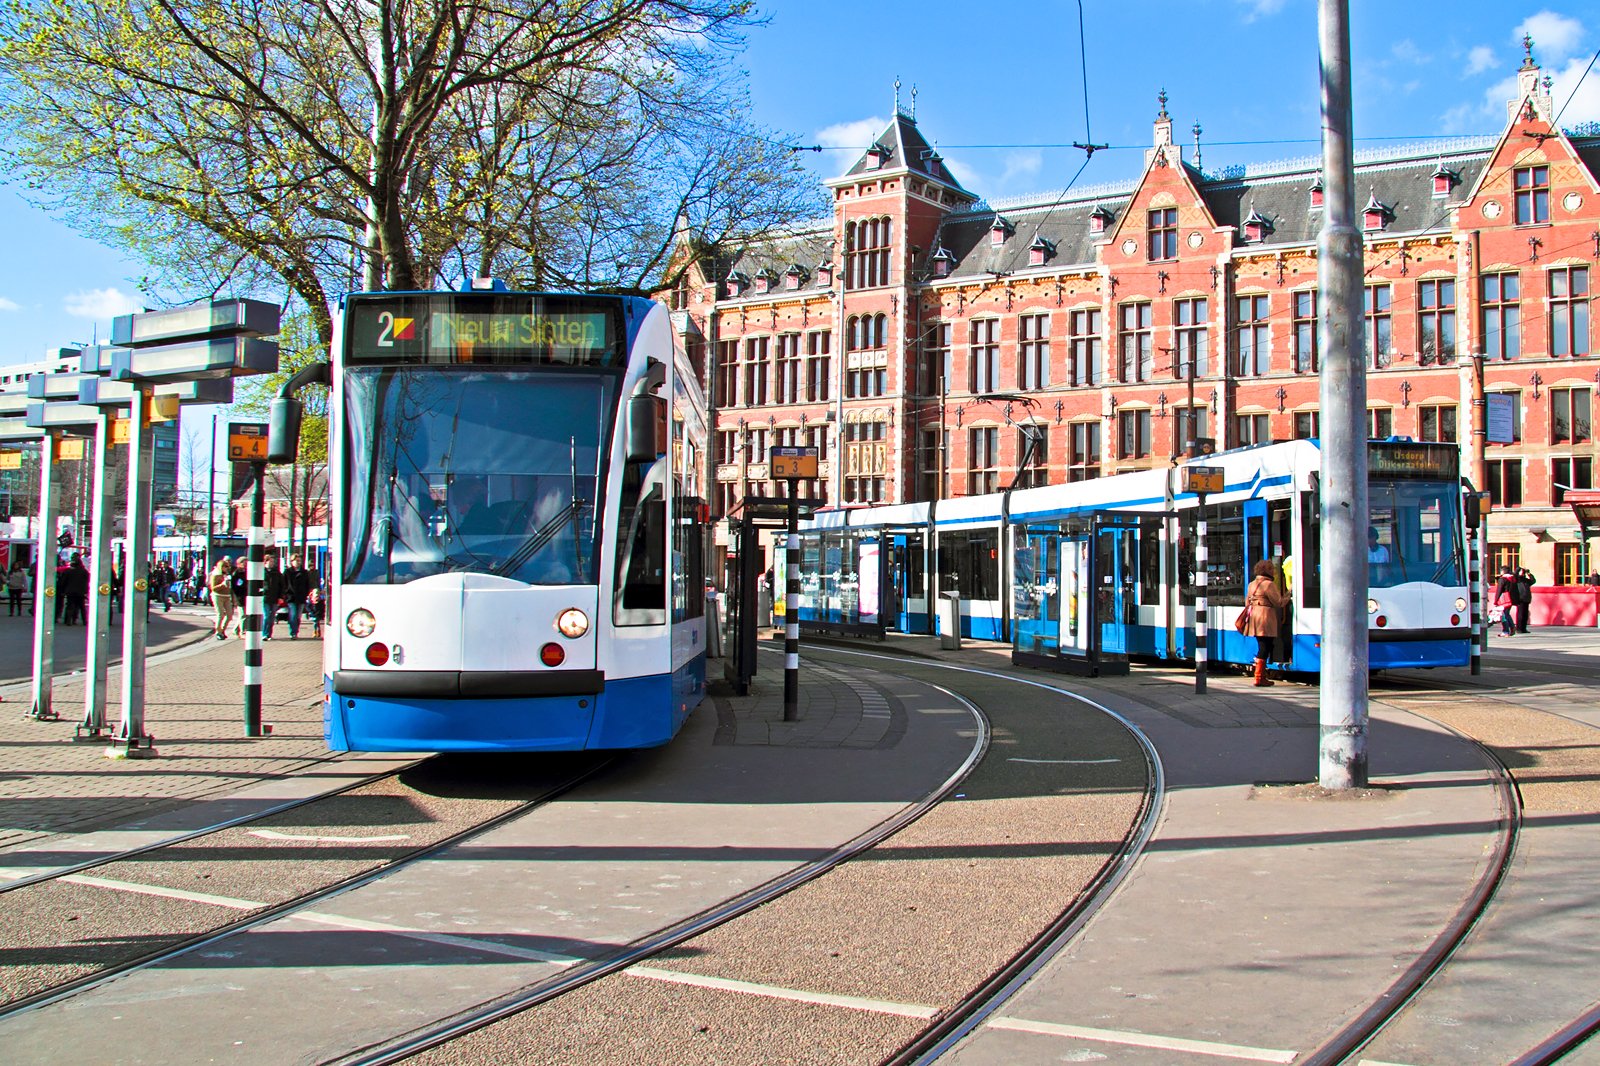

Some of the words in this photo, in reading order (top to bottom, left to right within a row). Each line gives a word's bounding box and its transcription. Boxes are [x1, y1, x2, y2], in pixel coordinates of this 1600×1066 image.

[377, 311, 394, 347] 2
[252, 441, 258, 454] 4
[792, 461, 798, 473] 3
[107, 472, 113, 480] 2
[1204, 477, 1210, 488] 2
